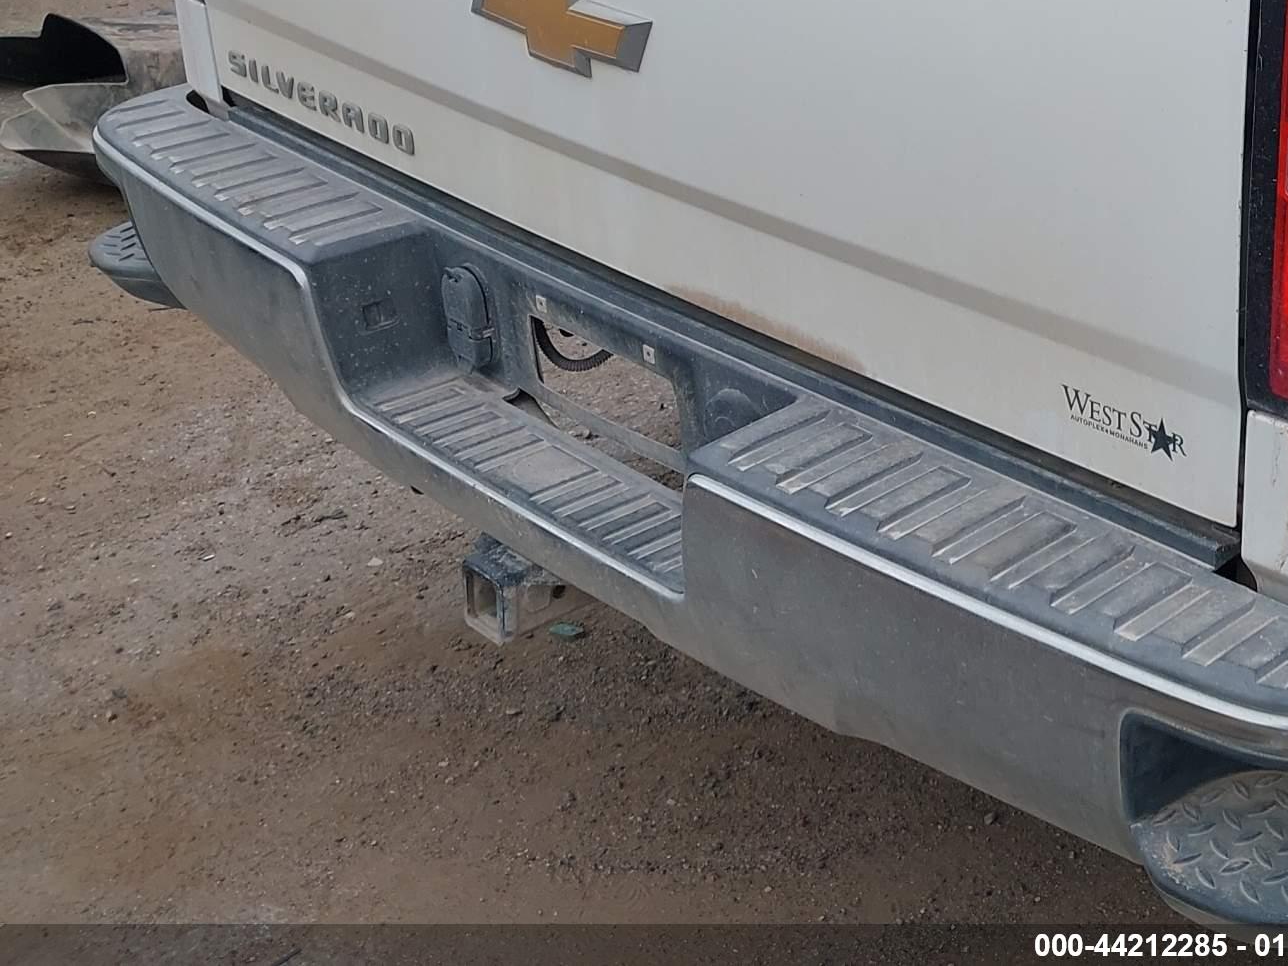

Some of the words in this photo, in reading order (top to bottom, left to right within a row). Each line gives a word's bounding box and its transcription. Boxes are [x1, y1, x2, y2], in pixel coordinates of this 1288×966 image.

[228, 50, 415, 156] SILVERADO
[1061, 384, 1126, 431] WEST
[1130, 411, 1187, 460] STR
